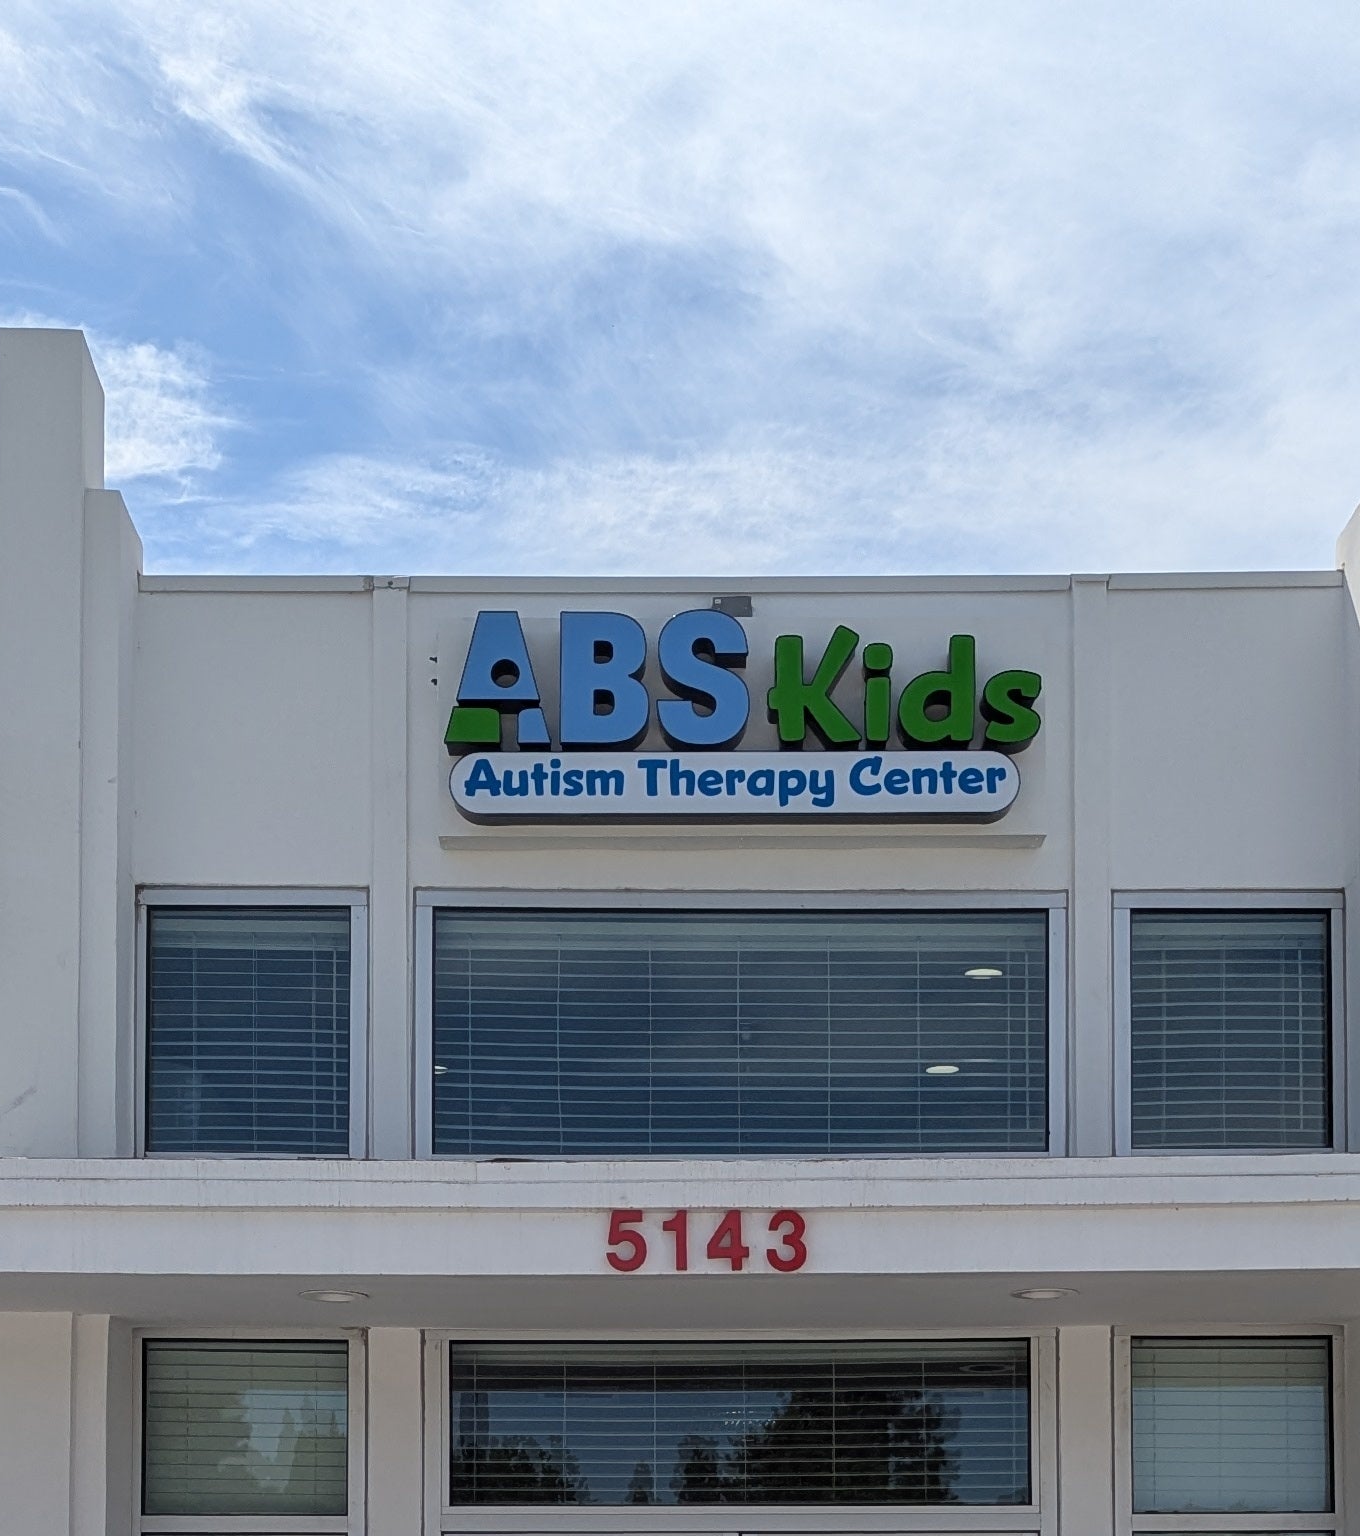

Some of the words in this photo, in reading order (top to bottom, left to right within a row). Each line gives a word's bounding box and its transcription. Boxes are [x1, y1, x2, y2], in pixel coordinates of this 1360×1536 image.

[444, 609, 750, 745] ABS
[768, 625, 1041, 744] Kids
[464, 758, 624, 797] Autism
[638, 759, 835, 807] Therapy
[849, 756, 1006, 796] Center
[606, 1209, 807, 1272] 5143
